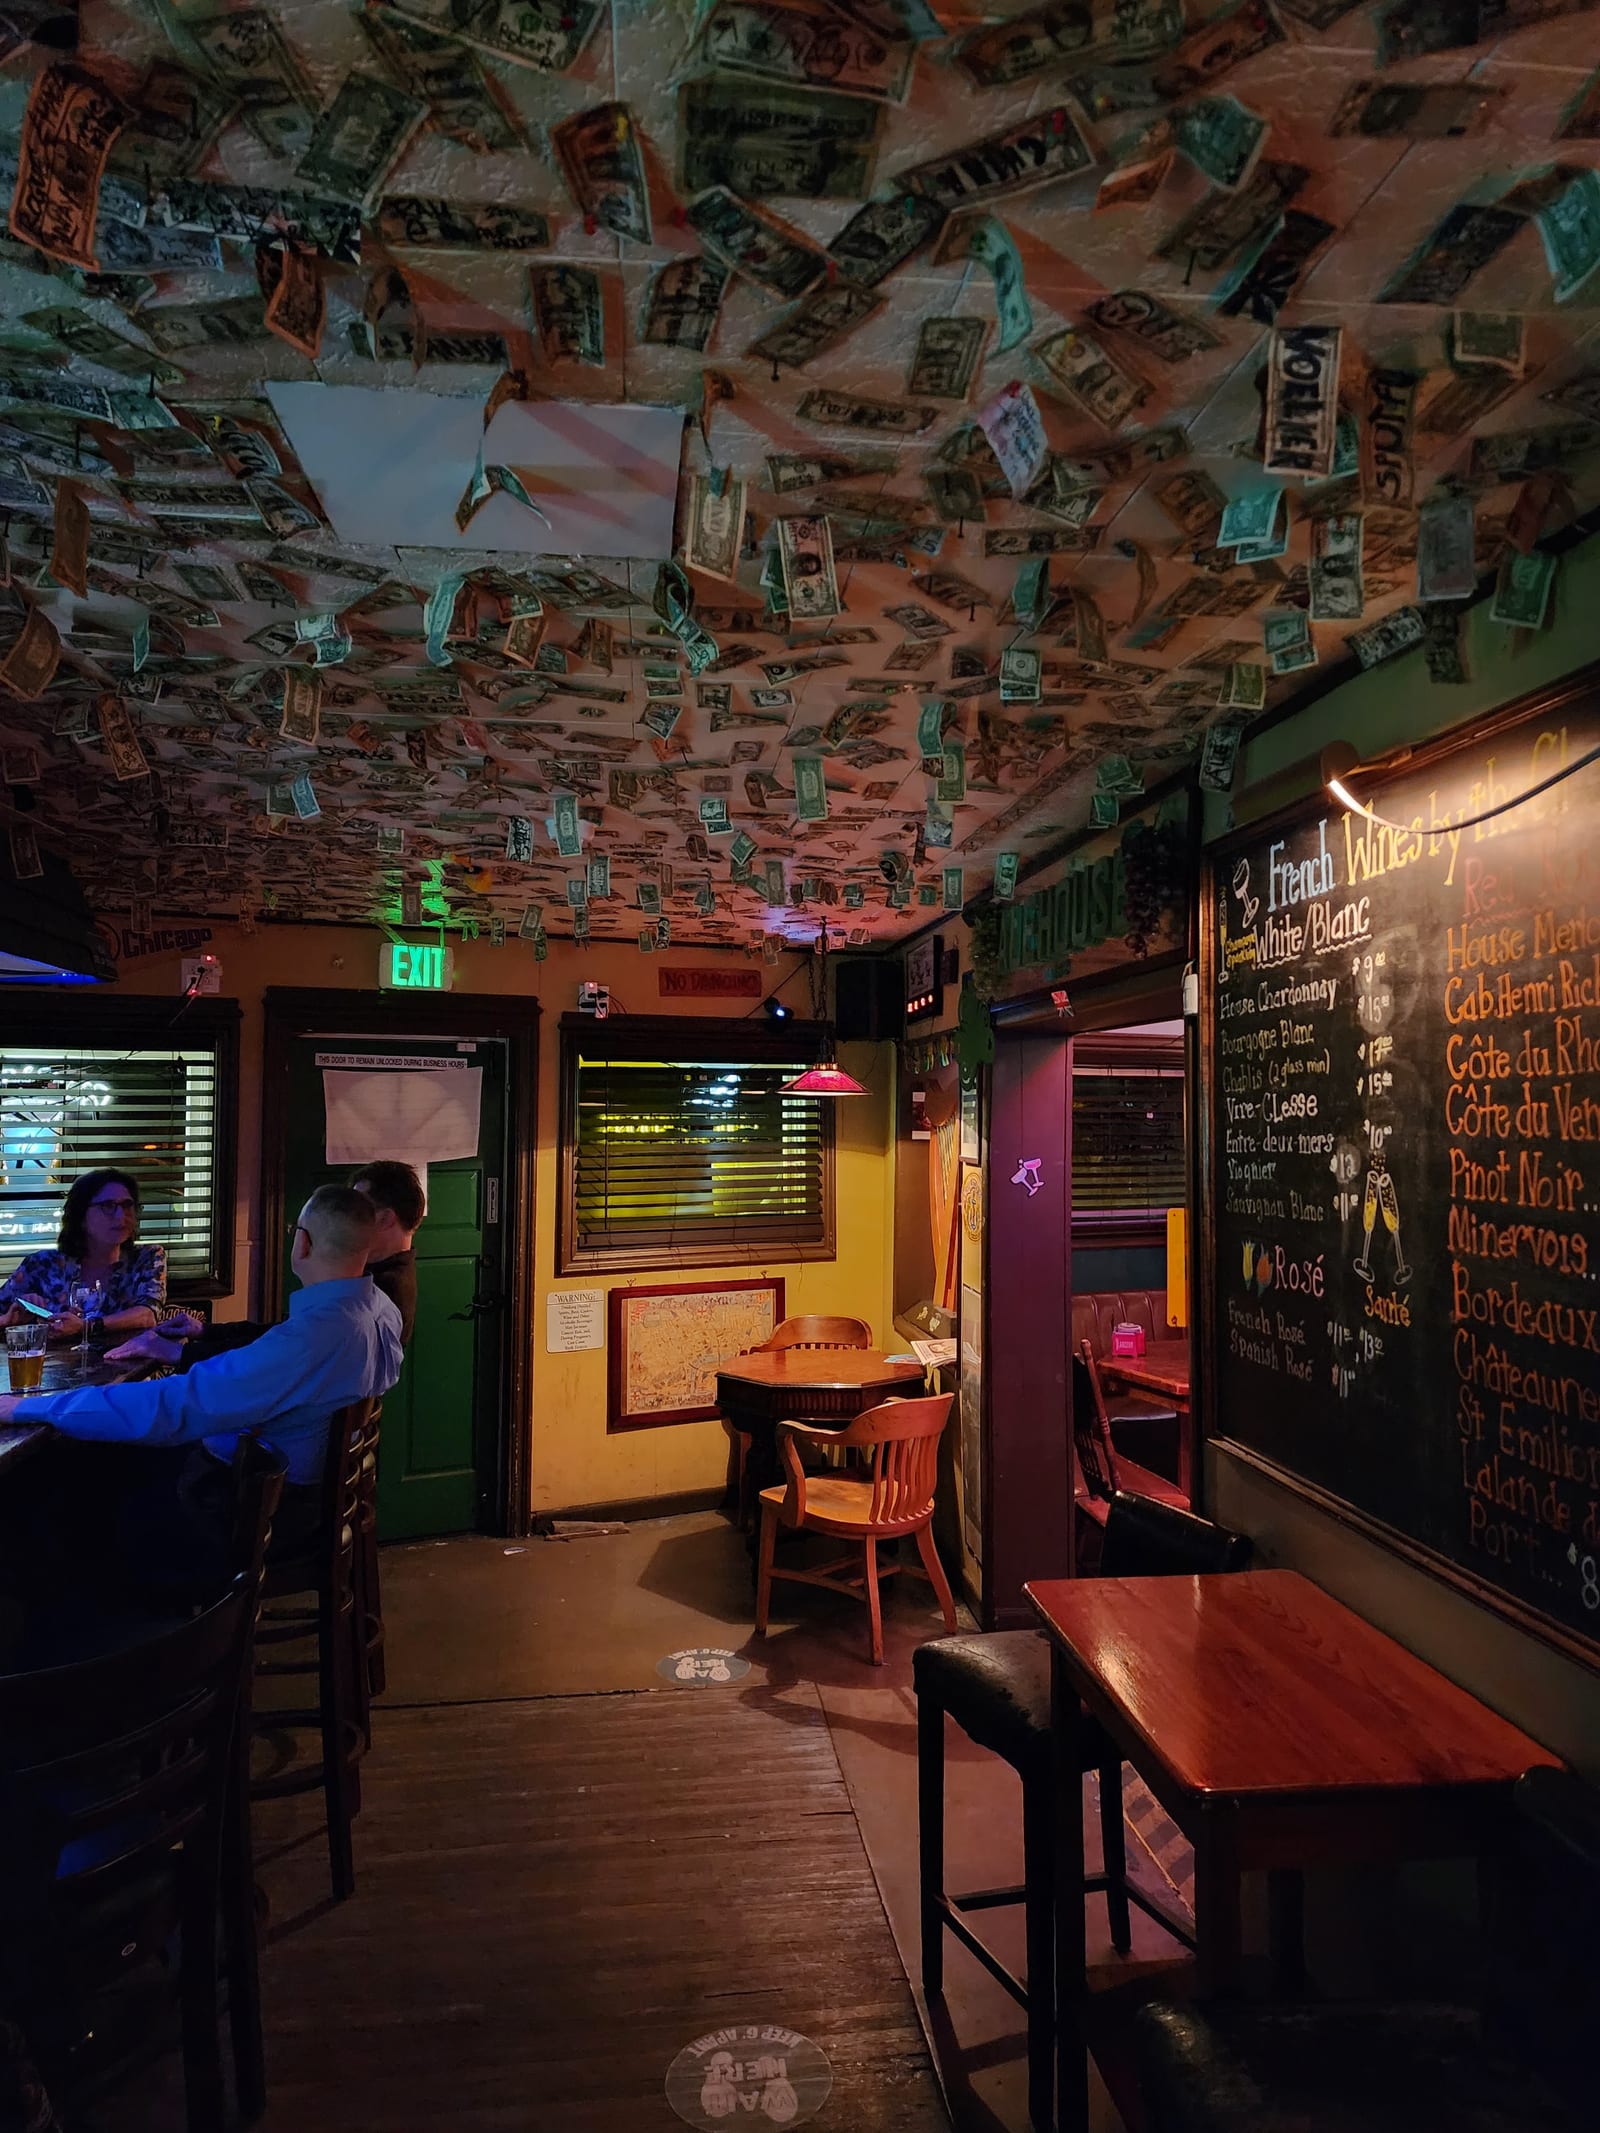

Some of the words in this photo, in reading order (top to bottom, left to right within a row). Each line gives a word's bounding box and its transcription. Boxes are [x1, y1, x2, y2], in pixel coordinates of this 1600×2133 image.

[1268, 818, 1337, 912] French
[1342, 798, 1423, 887] Wines
[1428, 790, 1466, 886] by
[1469, 757, 1524, 842] th
[122, 928, 213, 958] Chicago
[392, 944, 445, 988] EXIT
[1446, 923, 1526, 972] House
[664, 971, 687, 991] NO
[1219, 993, 1256, 1020] House
[1258, 976, 1341, 1012] Chardonnay
[1280, 1019, 1315, 1049] Blanc
[1446, 1032, 1512, 1080] Côte
[1516, 1029, 1552, 1078] du
[331, 1055, 346, 1064] DOOR
[356, 1057, 375, 1065] REMAIN
[376, 1057, 402, 1066] UNLOCKED
[403, 1058, 422, 1067] DURING
[423, 1059, 447, 1068] BUSINESS
[1445, 1082, 1512, 1138] Côte
[1515, 1081, 1551, 1138] du
[1449, 1147, 1512, 1203] Pinot
[1290, 1190, 1324, 1222] Blanc
[1447, 1203, 1588, 1274] Minervois
[1274, 1244, 1325, 1297] Rosé
[1228, 1297, 1272, 1336] French
[1276, 1311, 1306, 1345] Rosé
[1364, 1284, 1412, 1328] Santé
[1450, 1259, 1600, 1354] Bordeaux
[1229, 1328, 1280, 1371] Spanish
[1284, 1345, 1314, 1383] Rosé
[1456, 1383, 1485, 1441] St
[1459, 1436, 1571, 1533] Lalande
[1583, 1500, 1600, 1541] d
